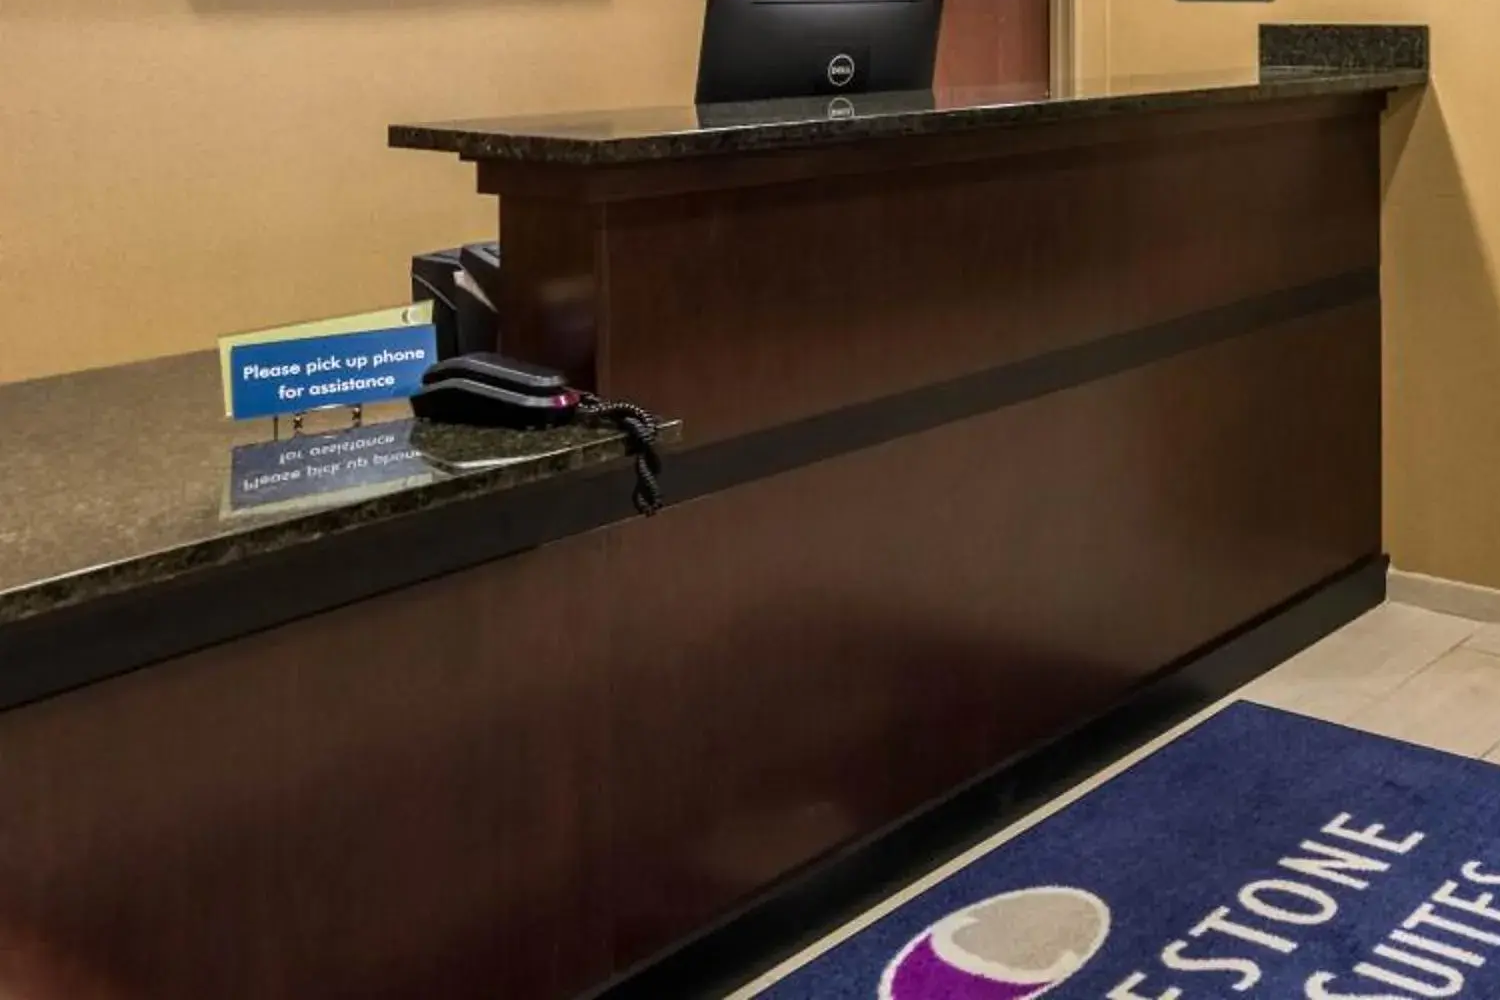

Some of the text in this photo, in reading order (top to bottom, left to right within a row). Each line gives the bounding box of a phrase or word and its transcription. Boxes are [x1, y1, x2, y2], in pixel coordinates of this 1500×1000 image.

[243, 349, 425, 380] Please pick up phone
[277, 374, 395, 400] for assistance
